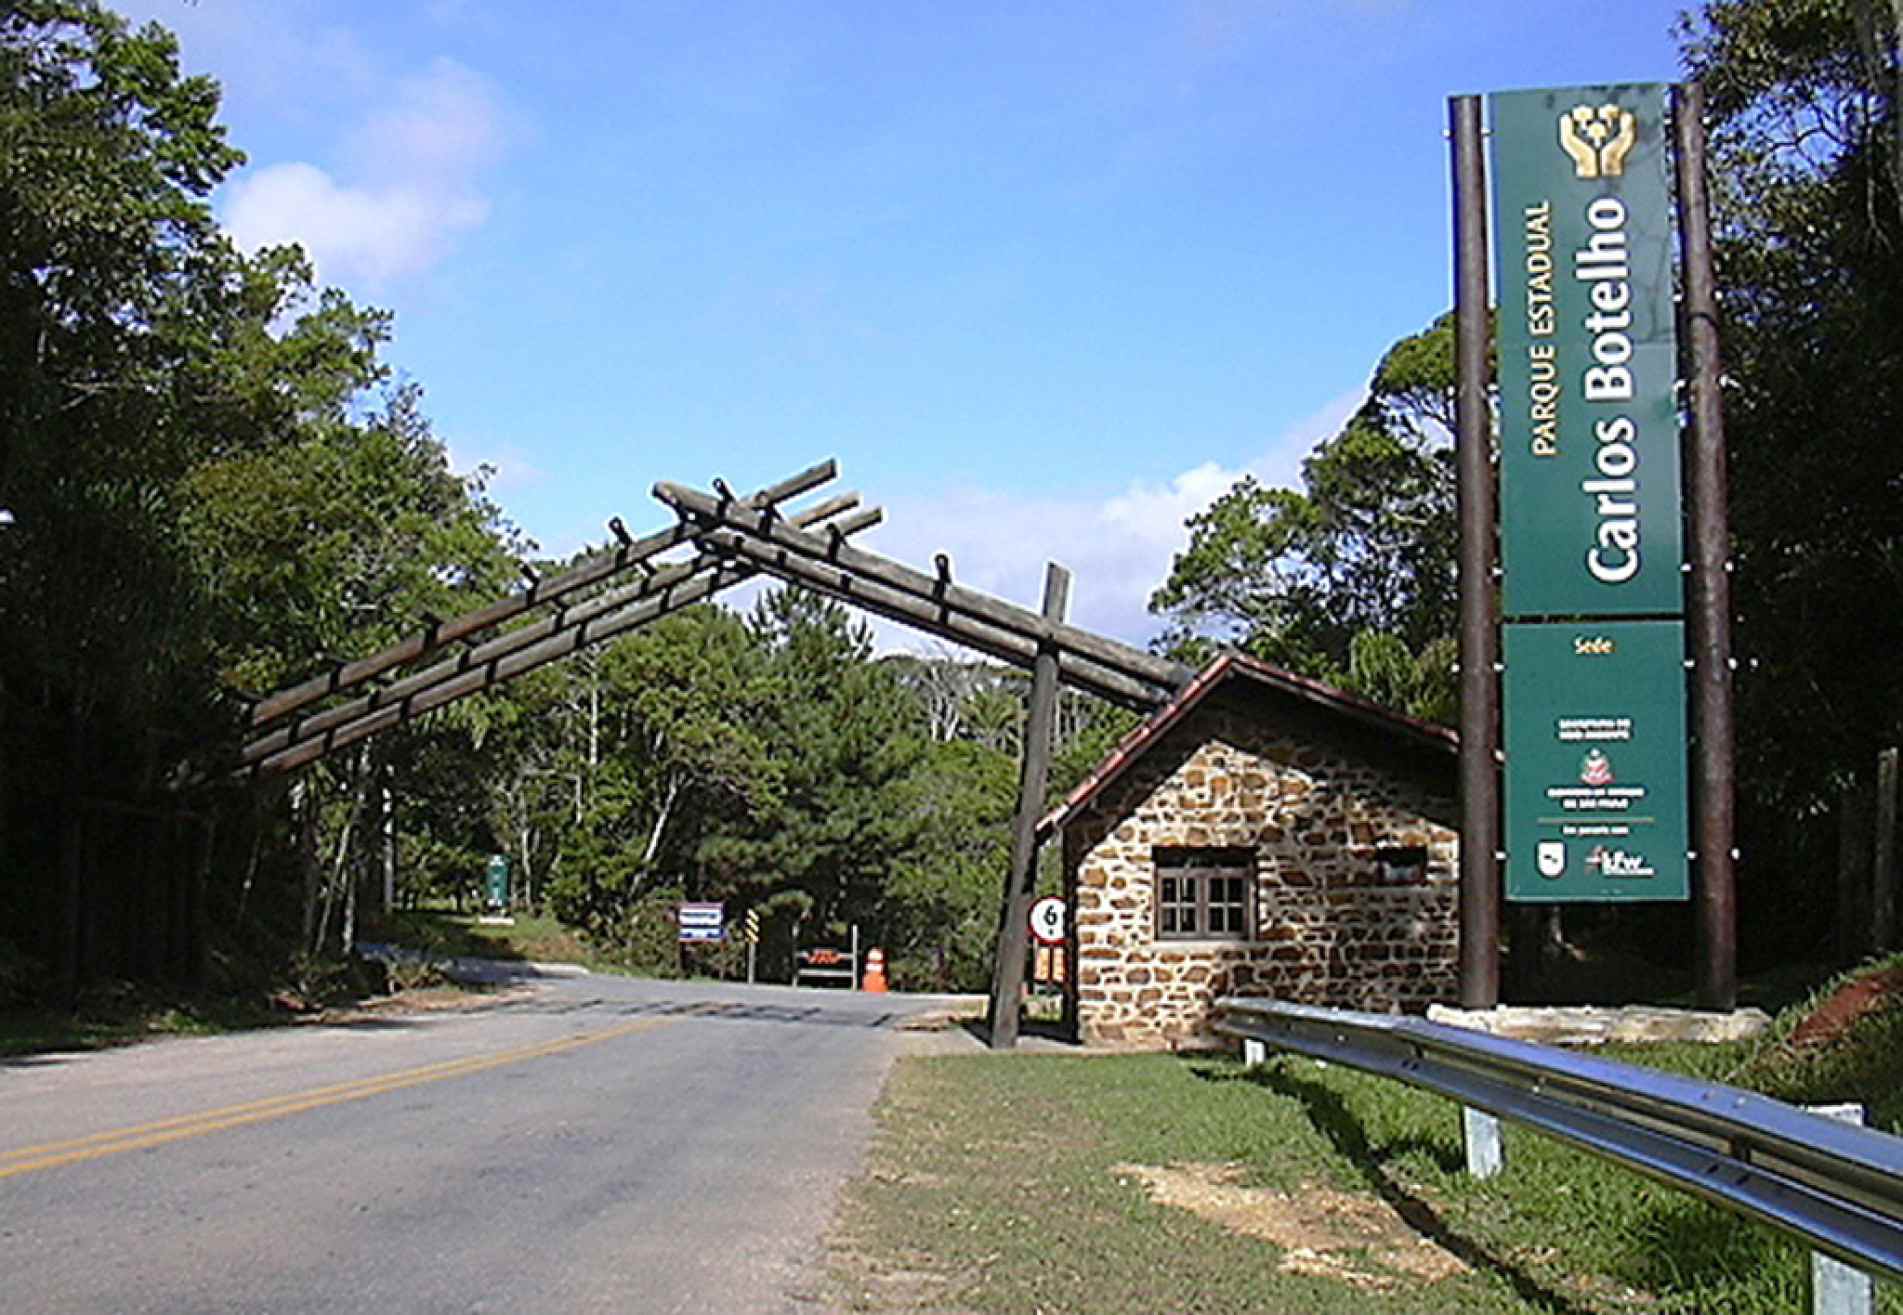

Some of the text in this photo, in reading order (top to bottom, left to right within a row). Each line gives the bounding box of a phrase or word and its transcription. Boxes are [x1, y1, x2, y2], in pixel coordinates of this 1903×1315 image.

[1525, 200, 1560, 456] PARQUE ESTADUAL
[1576, 198, 1638, 583] Carlos Botelho
[1043, 904, 1058, 926] 6
